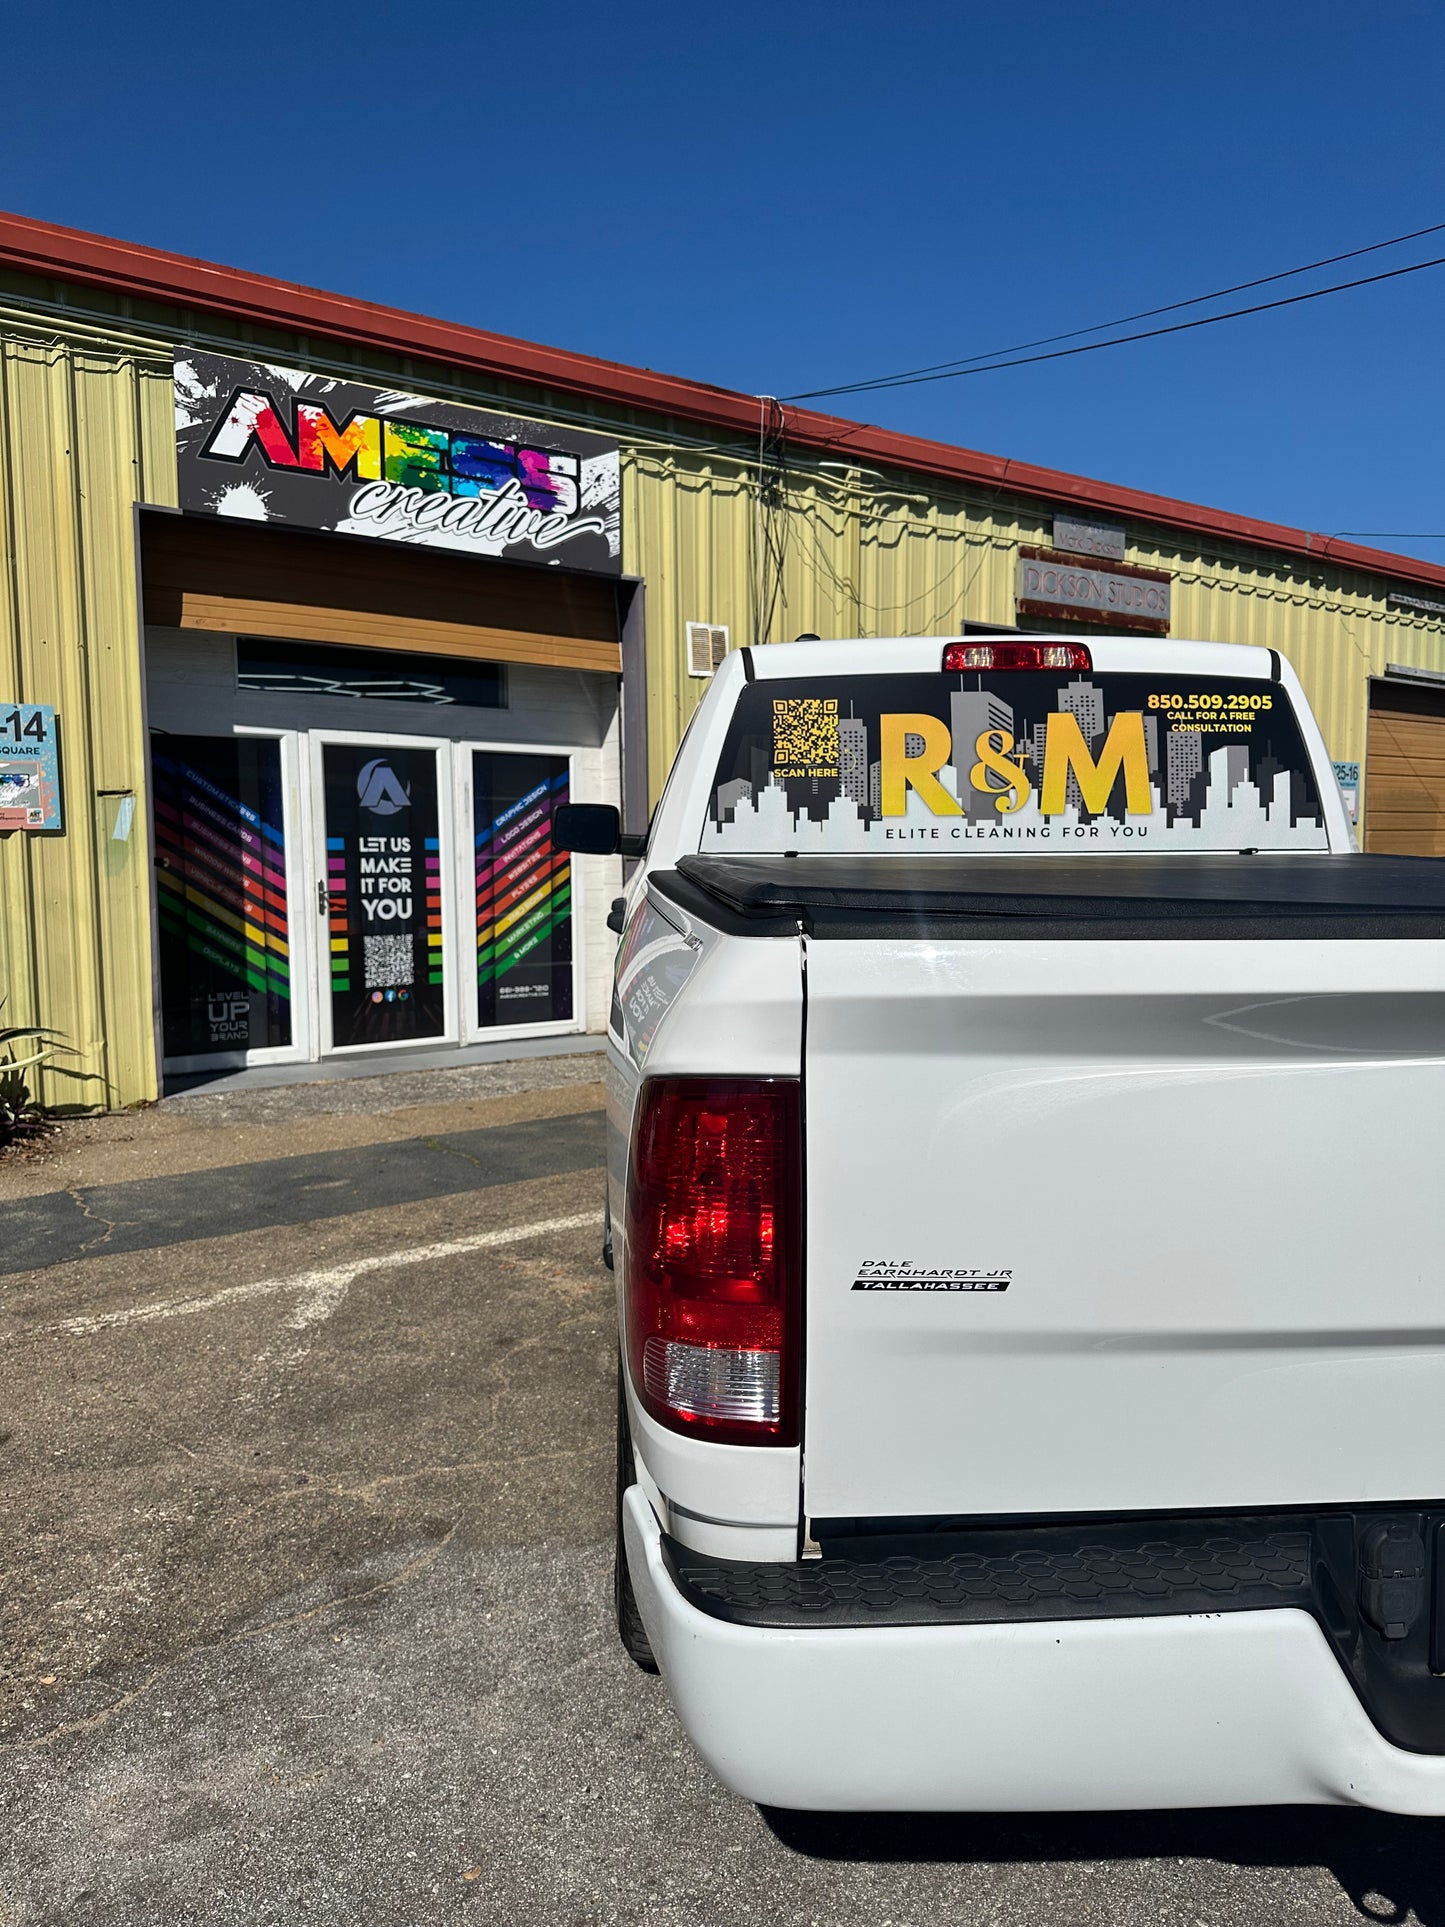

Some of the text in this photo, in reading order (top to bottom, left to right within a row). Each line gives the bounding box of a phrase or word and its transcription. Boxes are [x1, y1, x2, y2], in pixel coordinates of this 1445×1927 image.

[201, 387, 580, 519] AMESS
[350, 478, 605, 549] creative
[1027, 567, 1167, 612] DICKSON STUDIOS
[1147, 694, 1273, 710] 850.509.2905
[1167, 711, 1256, 720] CALL FOR A FREE
[1171, 723, 1252, 733] CONSULTATION
[0, 746, 40, 756] QUARE
[774, 768, 839, 778] SCAN HERE
[885, 826, 1148, 840] ELITE CLEANING FOR YOU
[359, 836, 411, 853] LET US
[360, 857, 412, 874] MAKE
[360, 877, 412, 894] IT FOR
[361, 898, 413, 922] YOU
[208, 991, 250, 1002] LEVEL
[208, 1001, 250, 1022] UP
[210, 1021, 248, 1032] YOUR
[211, 1030, 249, 1042] BRAND
[861, 1260, 913, 1268] DALE
[857, 1269, 1013, 1280] EARNHARDT JR
[861, 1281, 1000, 1290] TALLAHASSEE
